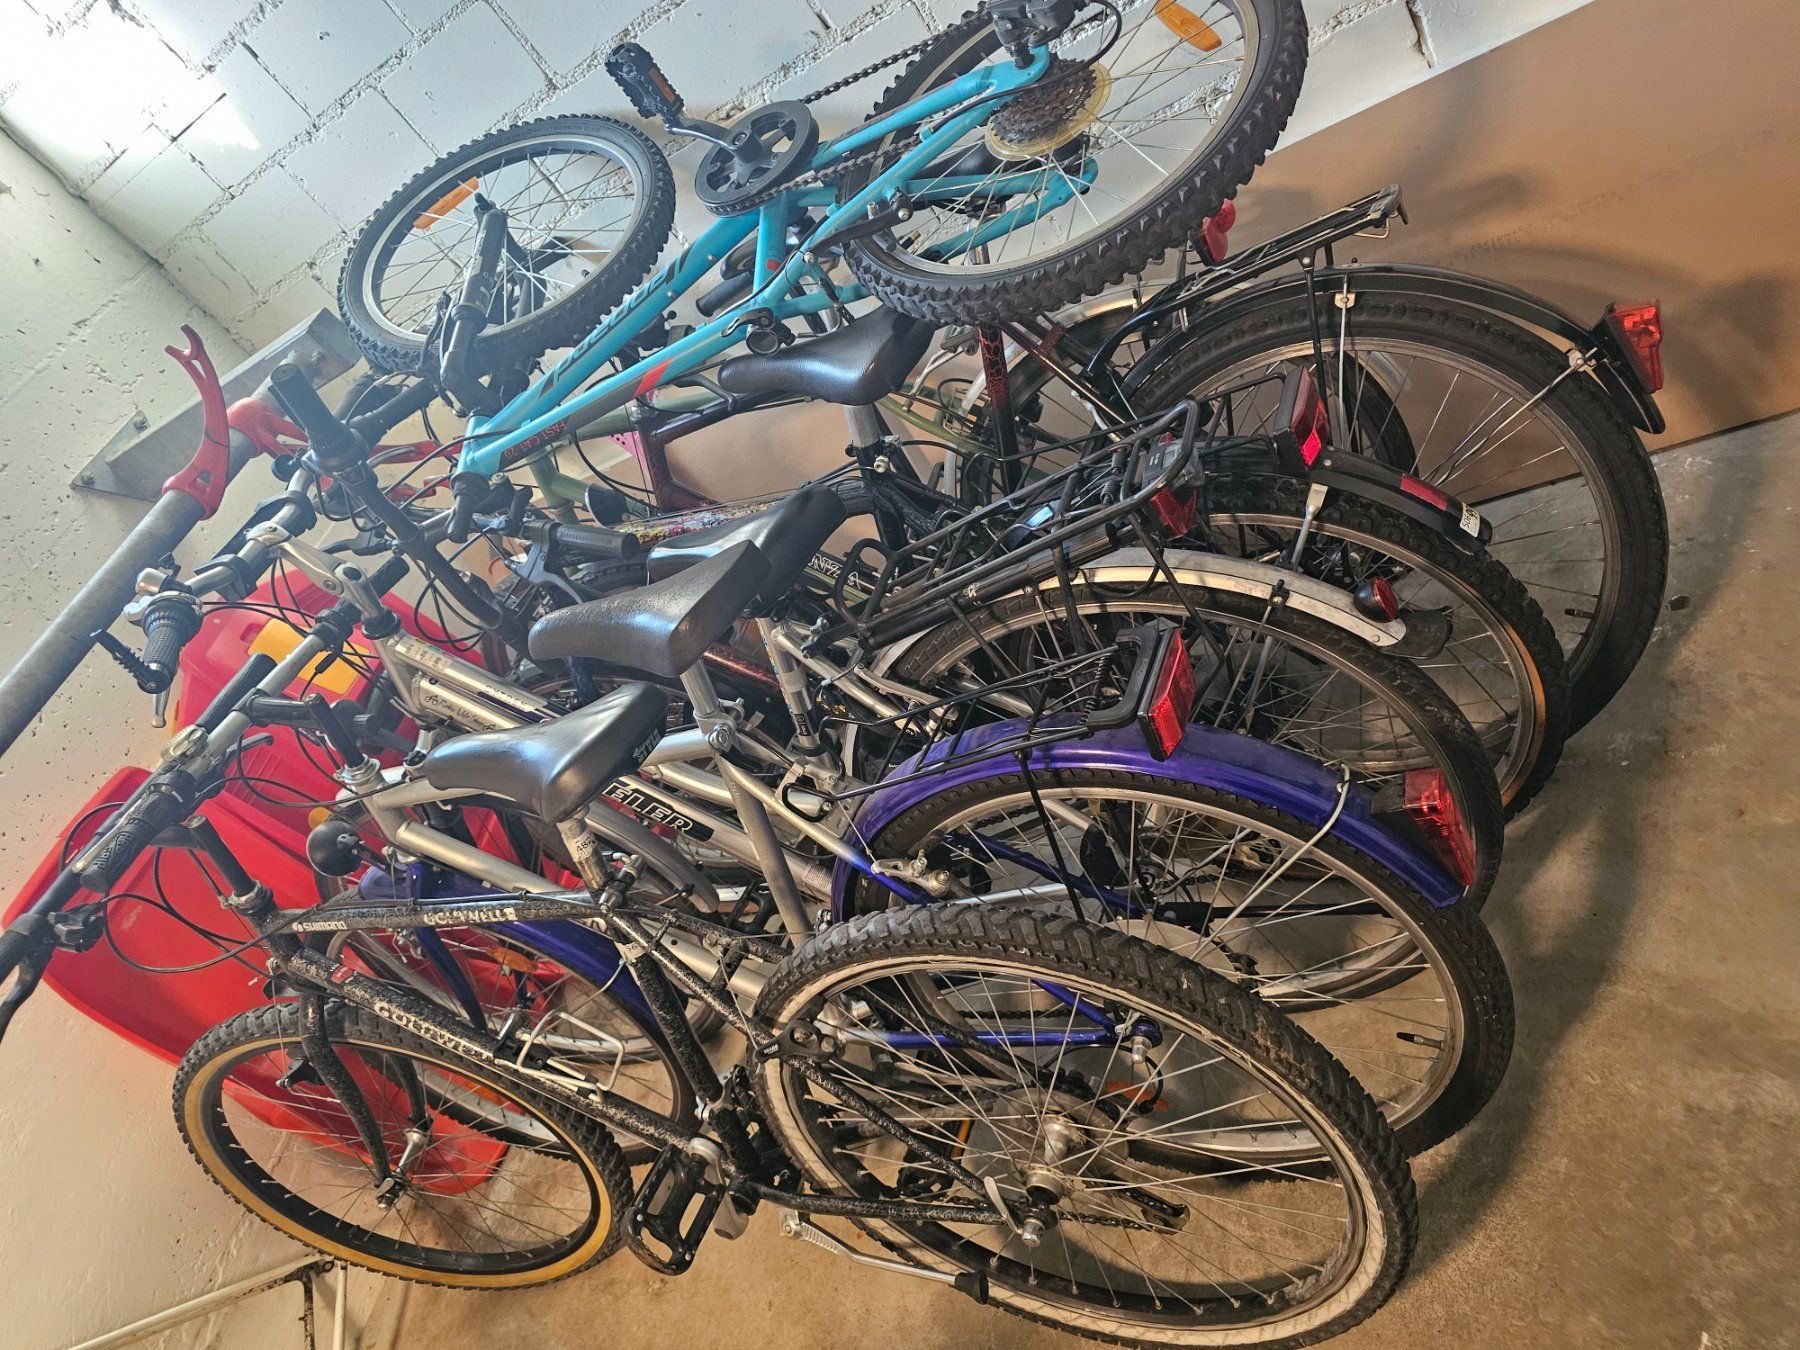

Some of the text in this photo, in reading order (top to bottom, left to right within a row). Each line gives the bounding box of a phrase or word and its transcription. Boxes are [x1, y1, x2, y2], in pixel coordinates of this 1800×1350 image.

[504, 421, 568, 459] FAST CAT 20
[302, 920, 348, 932] SHIMANO
